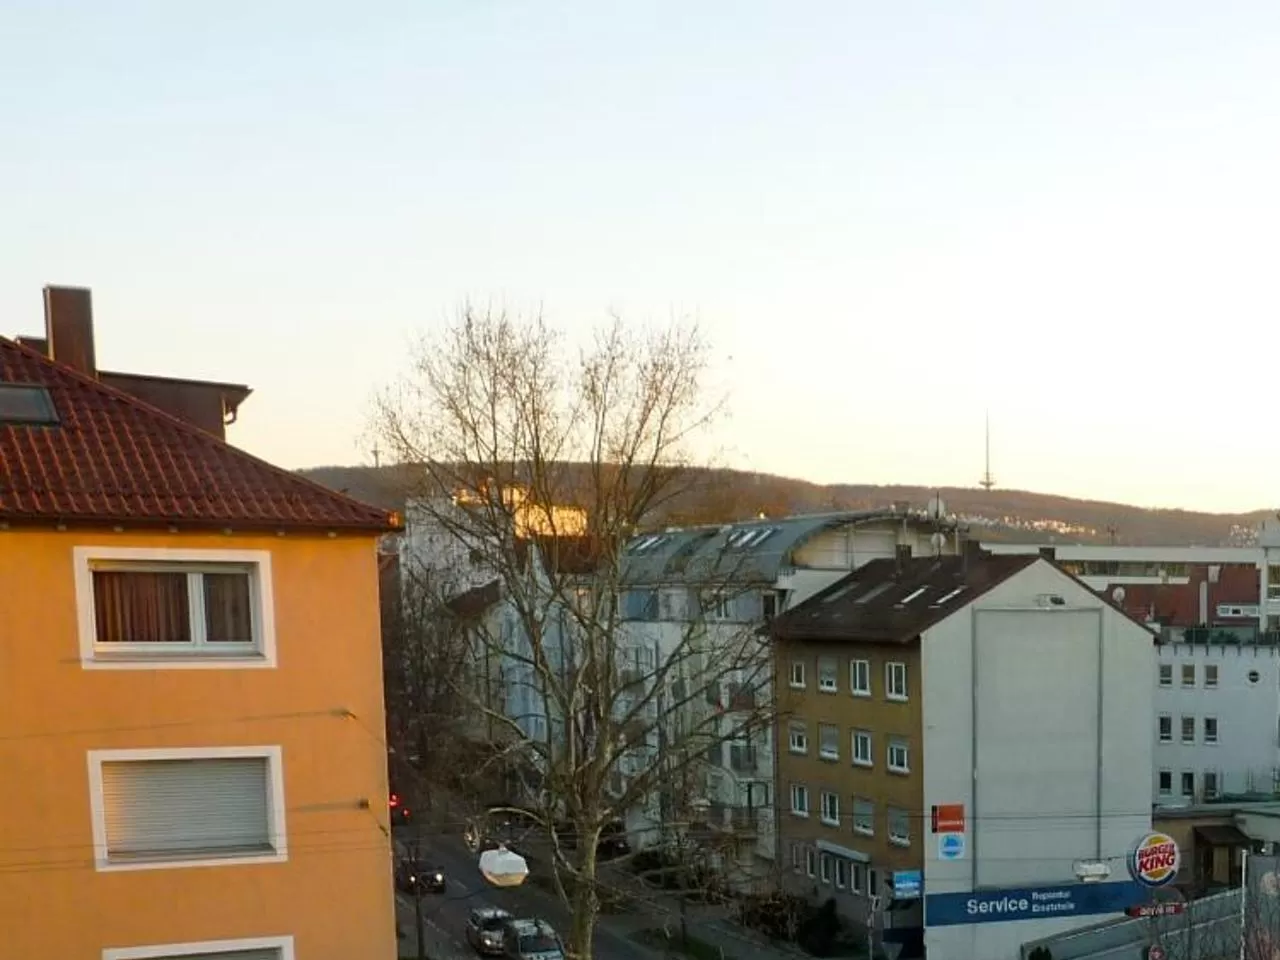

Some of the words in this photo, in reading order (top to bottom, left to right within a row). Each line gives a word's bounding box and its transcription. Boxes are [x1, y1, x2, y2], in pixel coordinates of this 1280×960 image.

[1139, 844, 1175, 858] BURGER
[1139, 855, 1175, 873] KING
[967, 897, 1028, 914] Service
